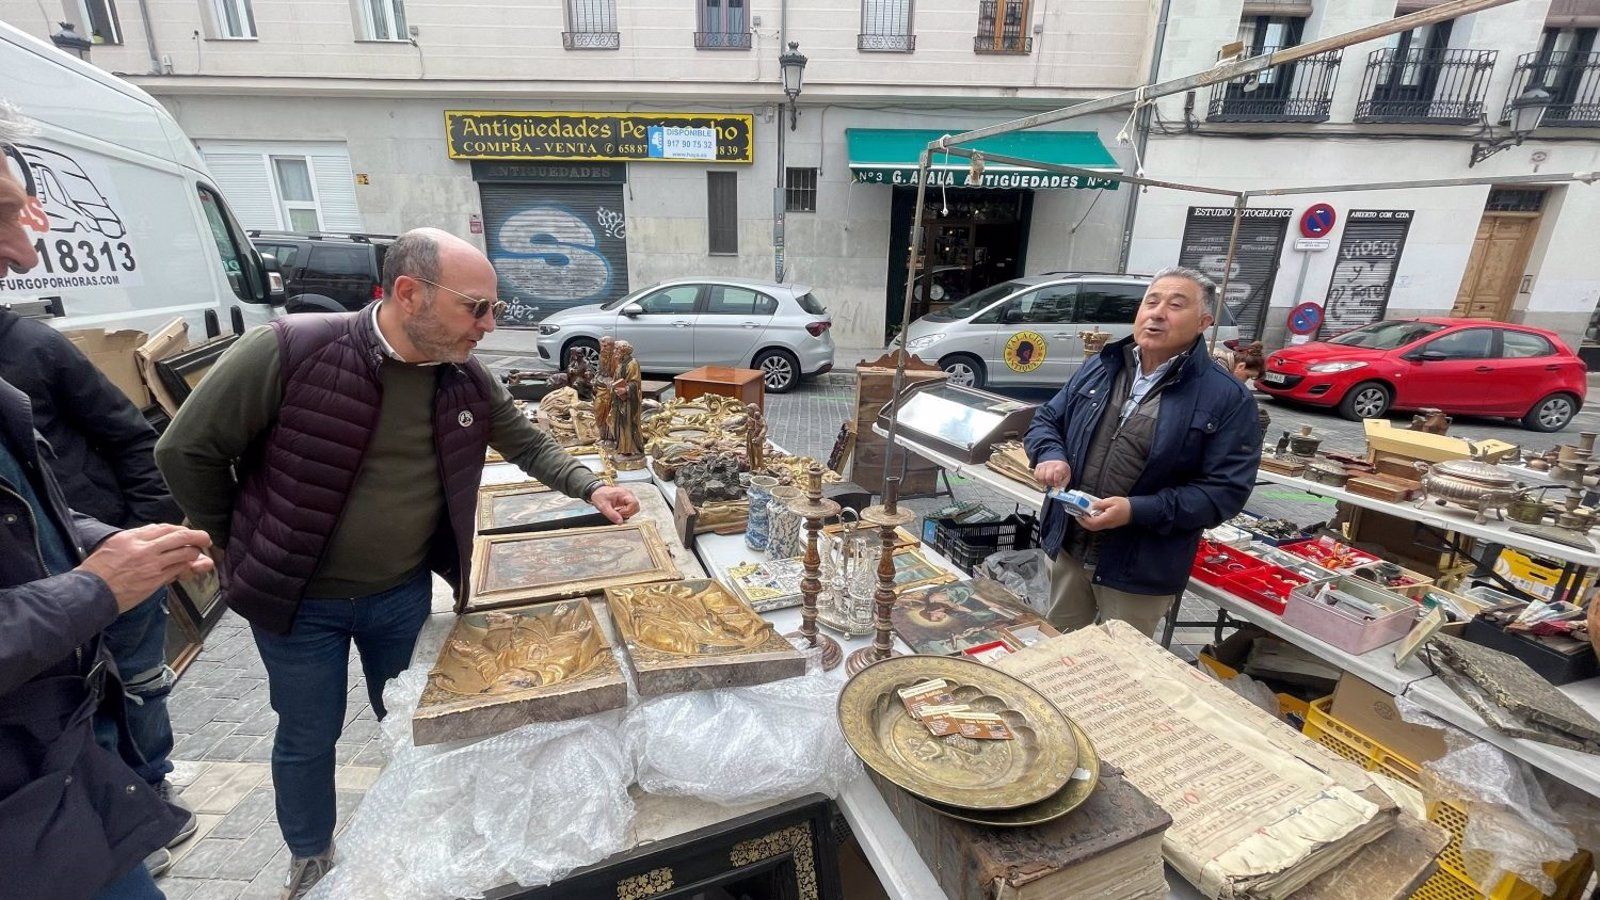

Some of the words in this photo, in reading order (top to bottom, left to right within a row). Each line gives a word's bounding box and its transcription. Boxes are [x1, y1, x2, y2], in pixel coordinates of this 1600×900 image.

[463, 118, 612, 141] Antigüedades
[666, 128, 712, 137] DISPONIBLE
[463, 141, 532, 152] COMPRA
[544, 142, 597, 153] VENTA
[618, 144, 635, 154] 658
[1194, 208, 1232, 217] ESTUDIO
[1350, 211, 1378, 219] ABIERTO
[1378, 211, 1393, 219] CON
[1394, 211, 1410, 219] CITA
